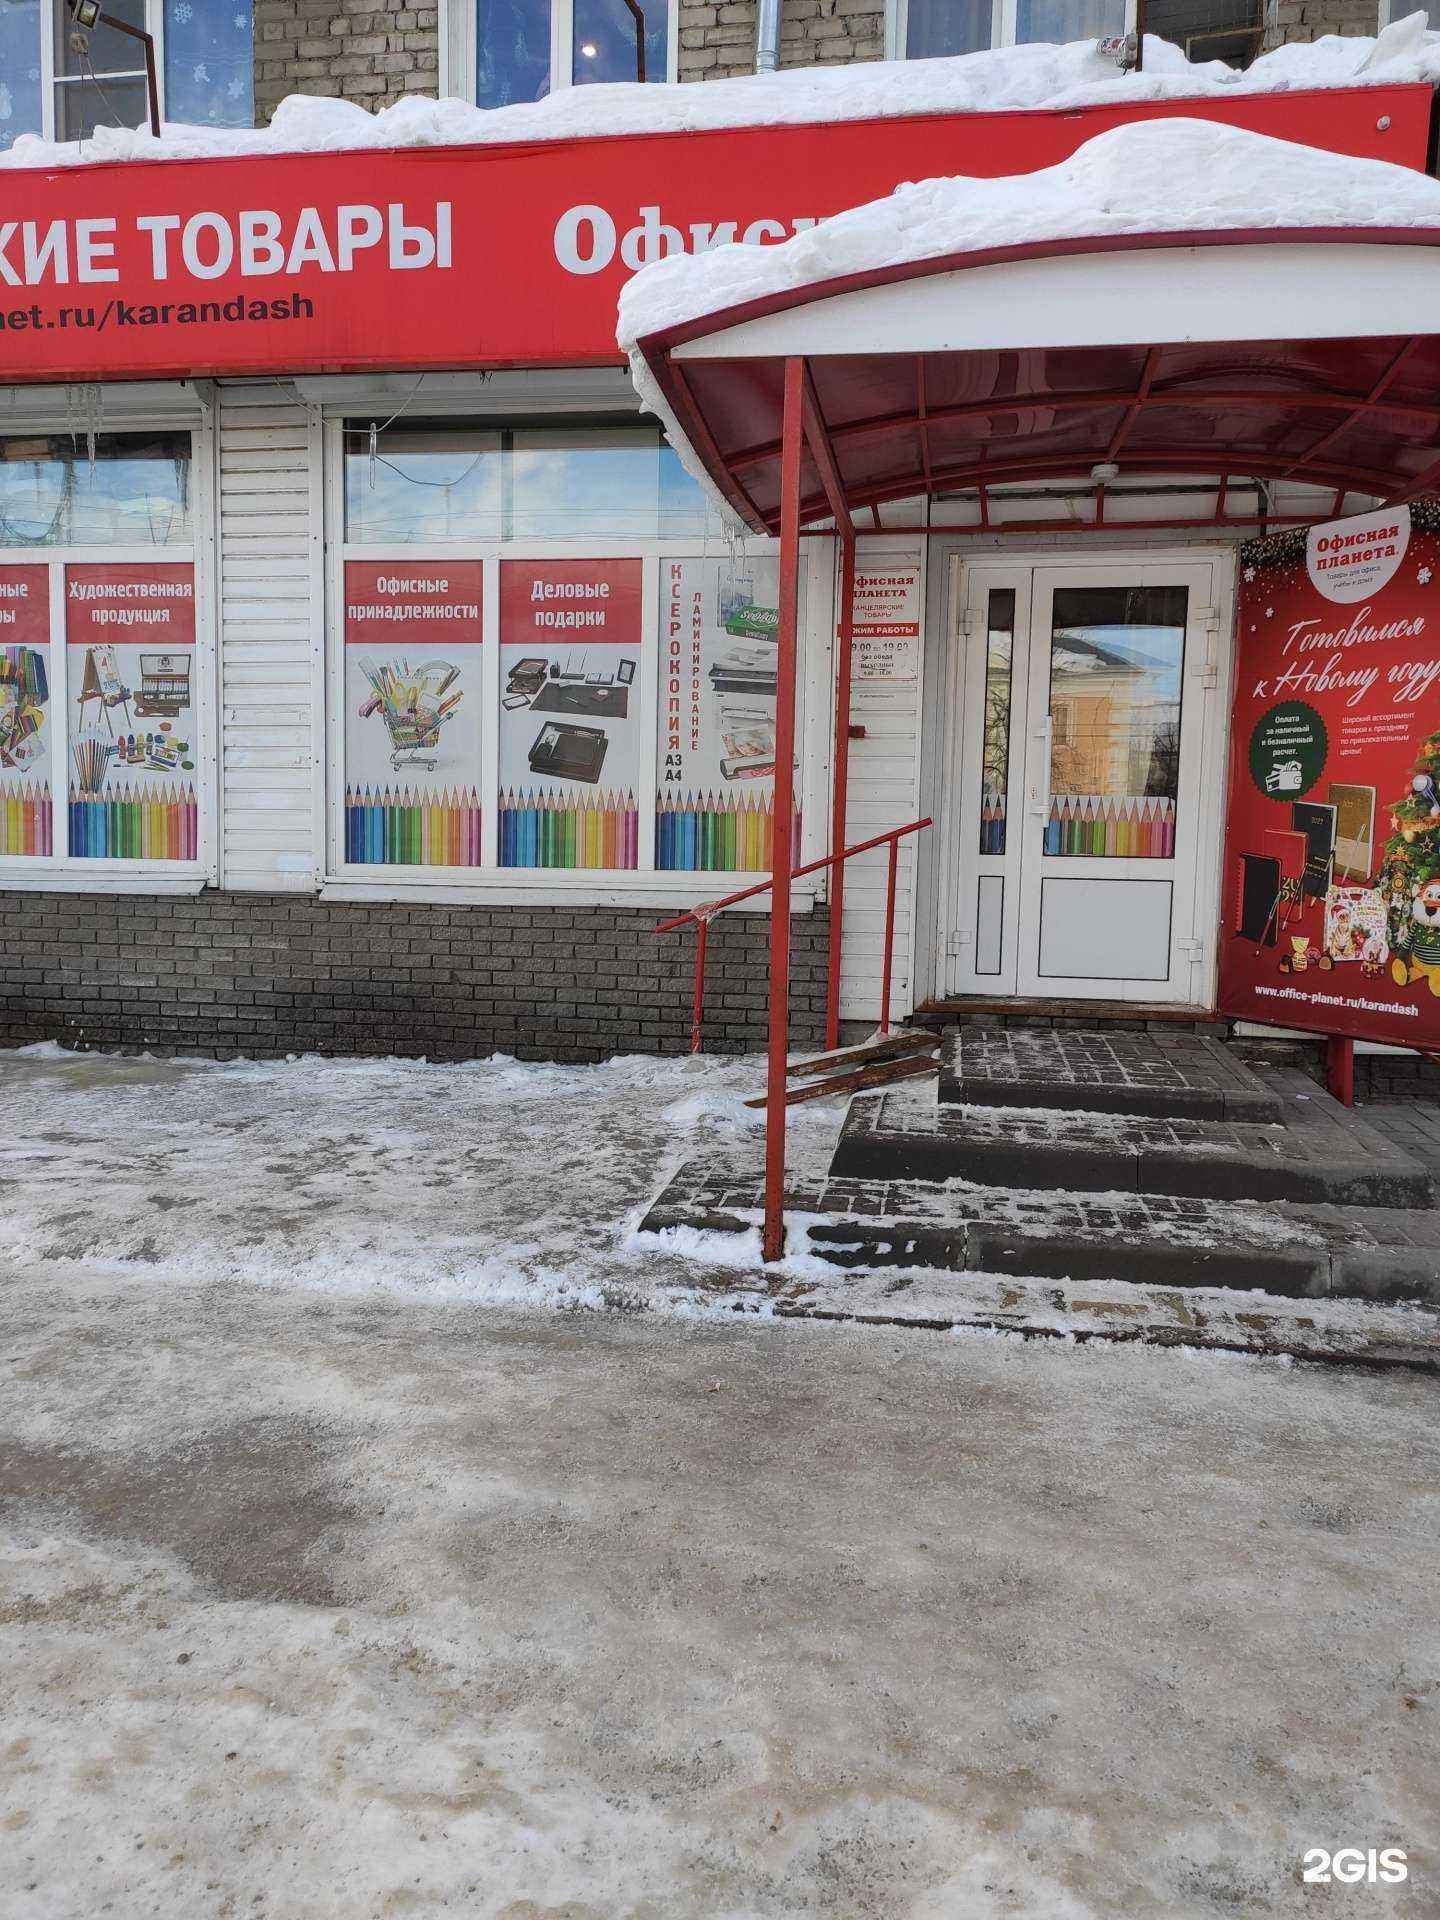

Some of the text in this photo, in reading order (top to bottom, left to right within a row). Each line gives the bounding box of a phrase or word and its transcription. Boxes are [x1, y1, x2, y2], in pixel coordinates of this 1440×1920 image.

[136, 201, 453, 281] ТОВАРЫ
[553, 203, 832, 275] Офис
[1317, 525, 1399, 553] Офисная
[69, 581, 192, 600] Художественная
[377, 576, 449, 596] Офисные
[531, 581, 610, 602] Деловые
[854, 576, 914, 589] фисная
[91, 608, 170, 625] продукция
[348, 603, 478, 622] принадлежности
[535, 611, 606, 628] подарки
[876, 626, 914, 634] РАБОТЫ
[1281, 606, 1426, 656] Готовимся
[668, 564, 682, 751] КСЕРОКОПИЯ
[691, 592, 701, 751] ЛАМИНИРОВАНИЕ
[1252, 652, 1440, 707] к Новому году
[1275, 715, 1300, 724] Оплата
[1342, 711, 1416, 724] Широкий ассортимент
[1275, 724, 1310, 735] наличный
[1374, 724, 1409, 733] празднику
[1267, 734, 1314, 746] безналичный
[1349, 734, 1410, 746] привлекательным
[1254, 983, 1419, 1017] www.office-planet.ru/karandash
